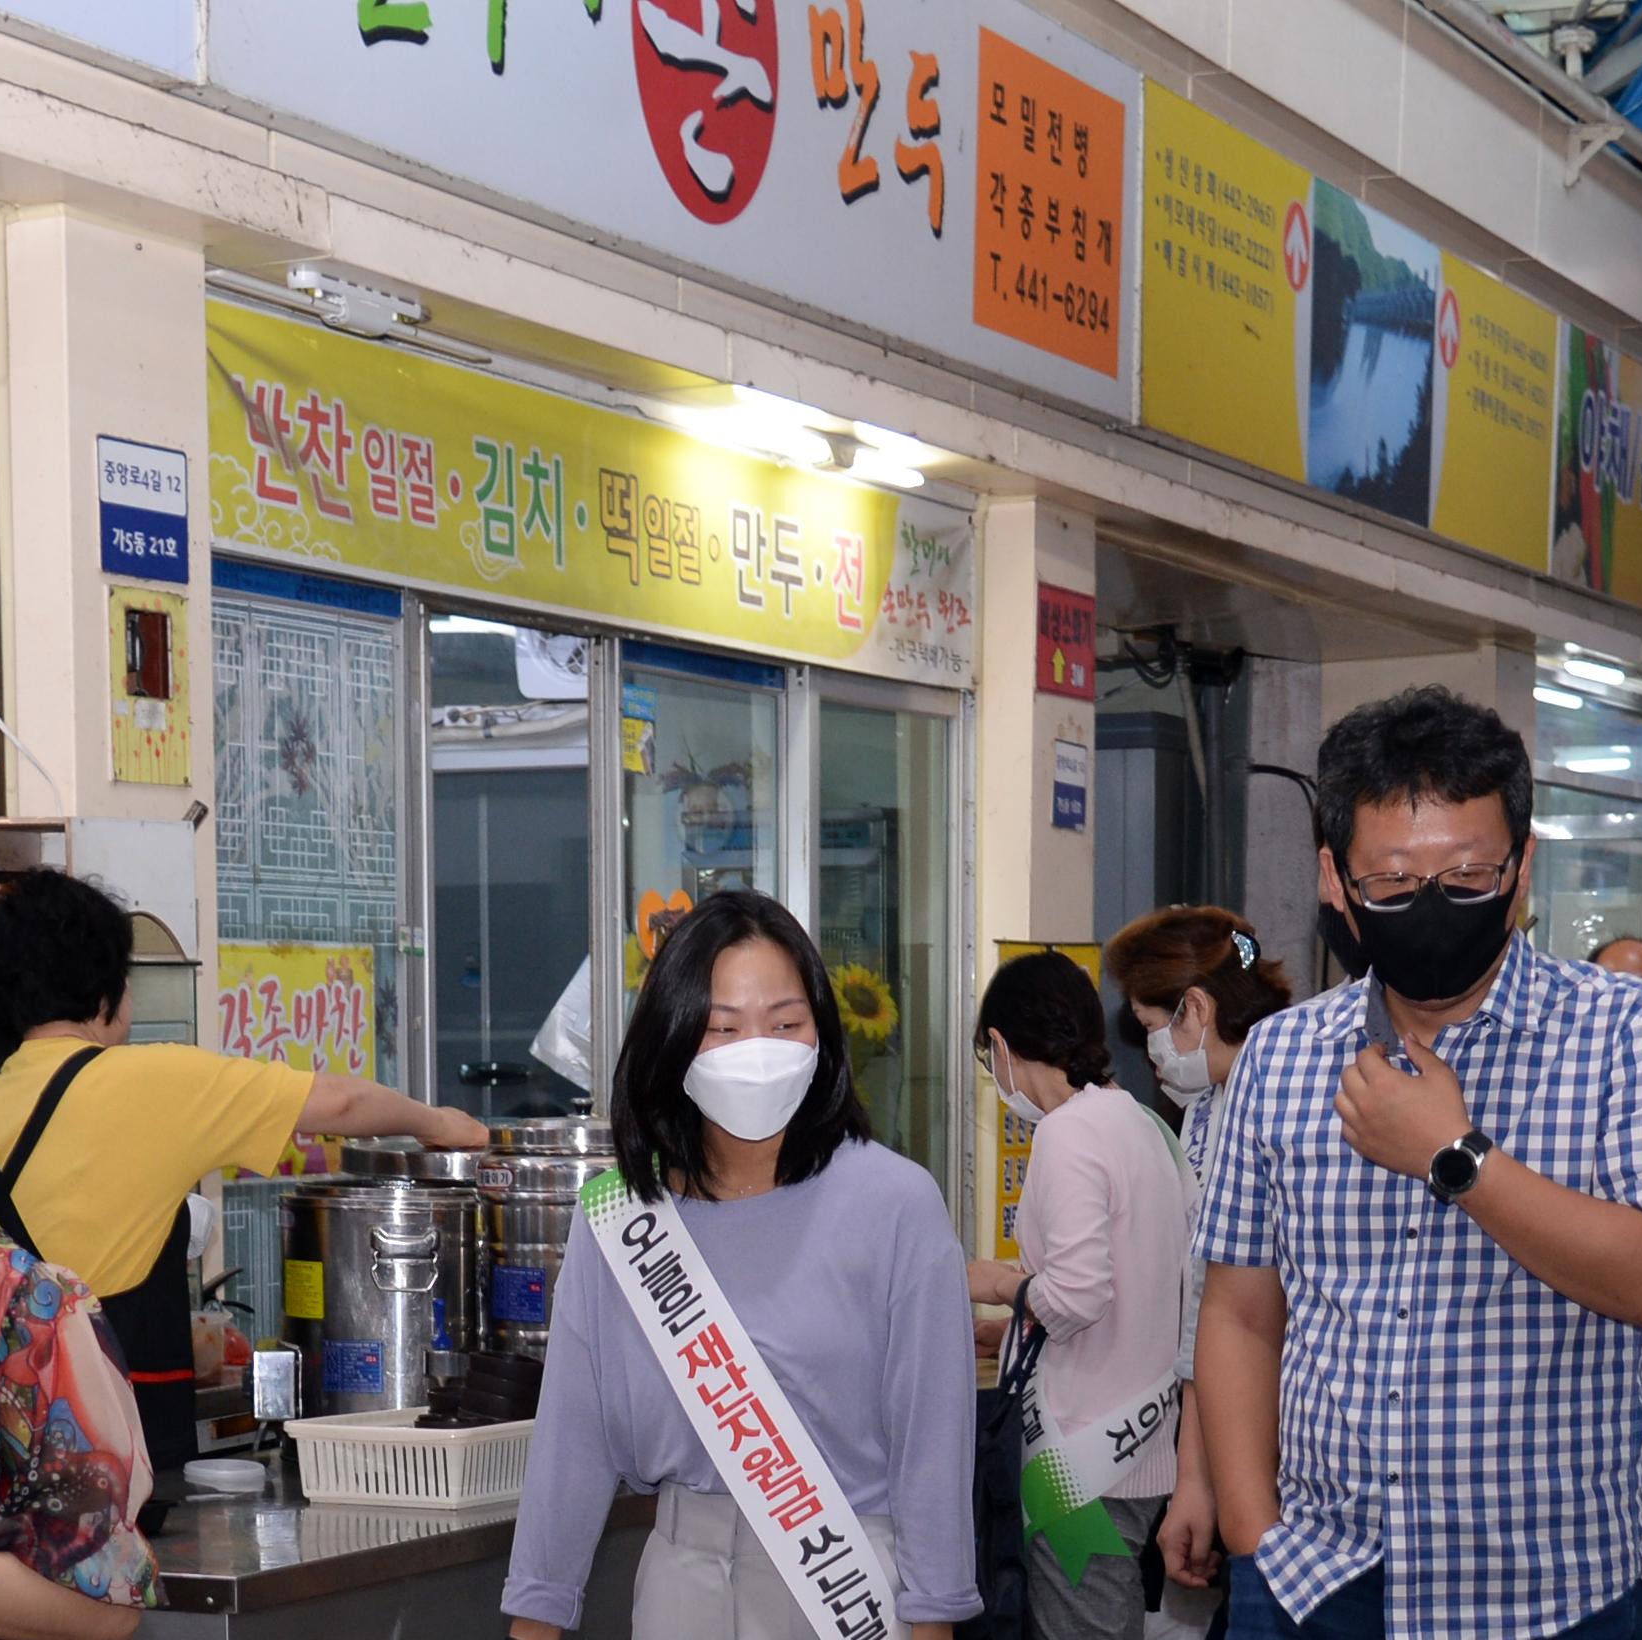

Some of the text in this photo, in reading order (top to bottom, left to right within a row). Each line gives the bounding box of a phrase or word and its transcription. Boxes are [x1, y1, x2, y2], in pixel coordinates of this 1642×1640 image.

[104, 459, 182, 493] 중앙로4길 12
[112, 527, 179, 558] 가5동 21호
[473, 438, 564, 568] 김치
[731, 508, 804, 616] 만두
[833, 535, 864, 631] 전
[219, 977, 365, 1072] 각종반찬
[621, 1212, 707, 1337] 오늘은
[677, 1321, 824, 1533] 재난지원금
